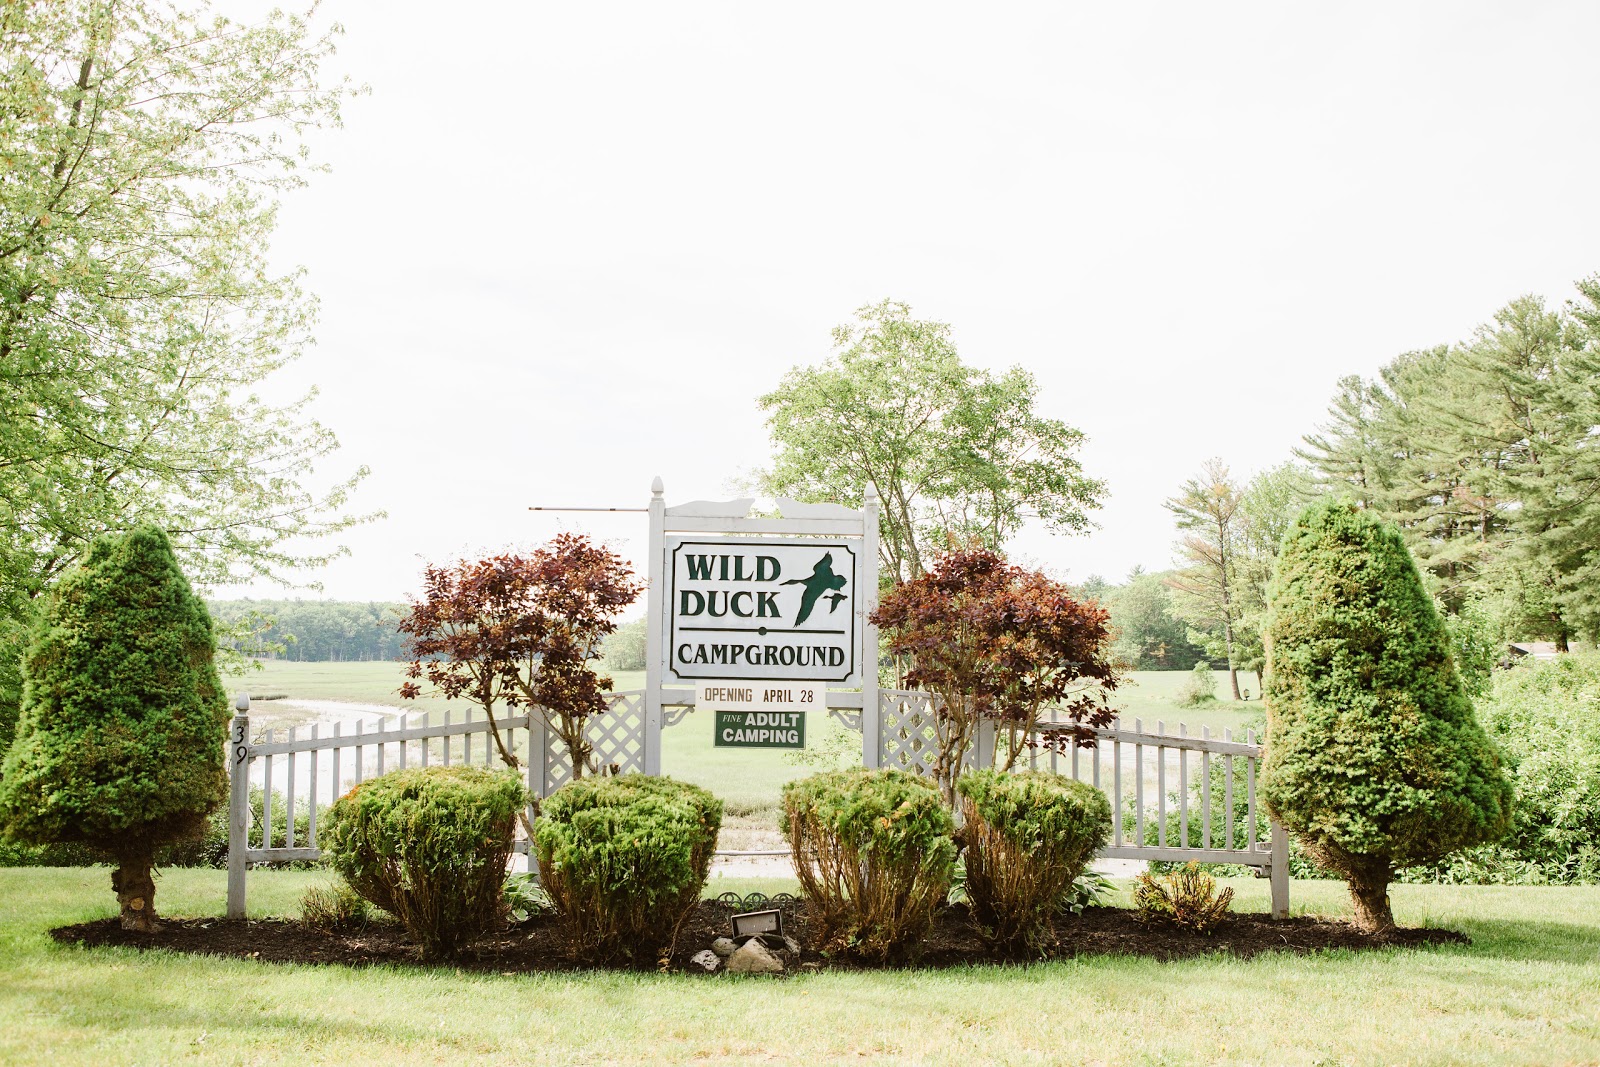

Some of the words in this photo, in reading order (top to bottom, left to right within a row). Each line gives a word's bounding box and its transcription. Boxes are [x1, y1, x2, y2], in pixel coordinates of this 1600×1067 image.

[685, 554, 781, 582] WILD
[679, 590, 782, 618] DUCK
[677, 643, 845, 667] CAMPGROUND
[704, 687, 753, 702] OPENING
[763, 689, 793, 703] APRIL
[800, 690, 814, 703] 28
[722, 714, 742, 723] FINE
[745, 713, 800, 727] ADULT
[233, 726, 248, 765] 39
[722, 728, 799, 743] CAMPING
